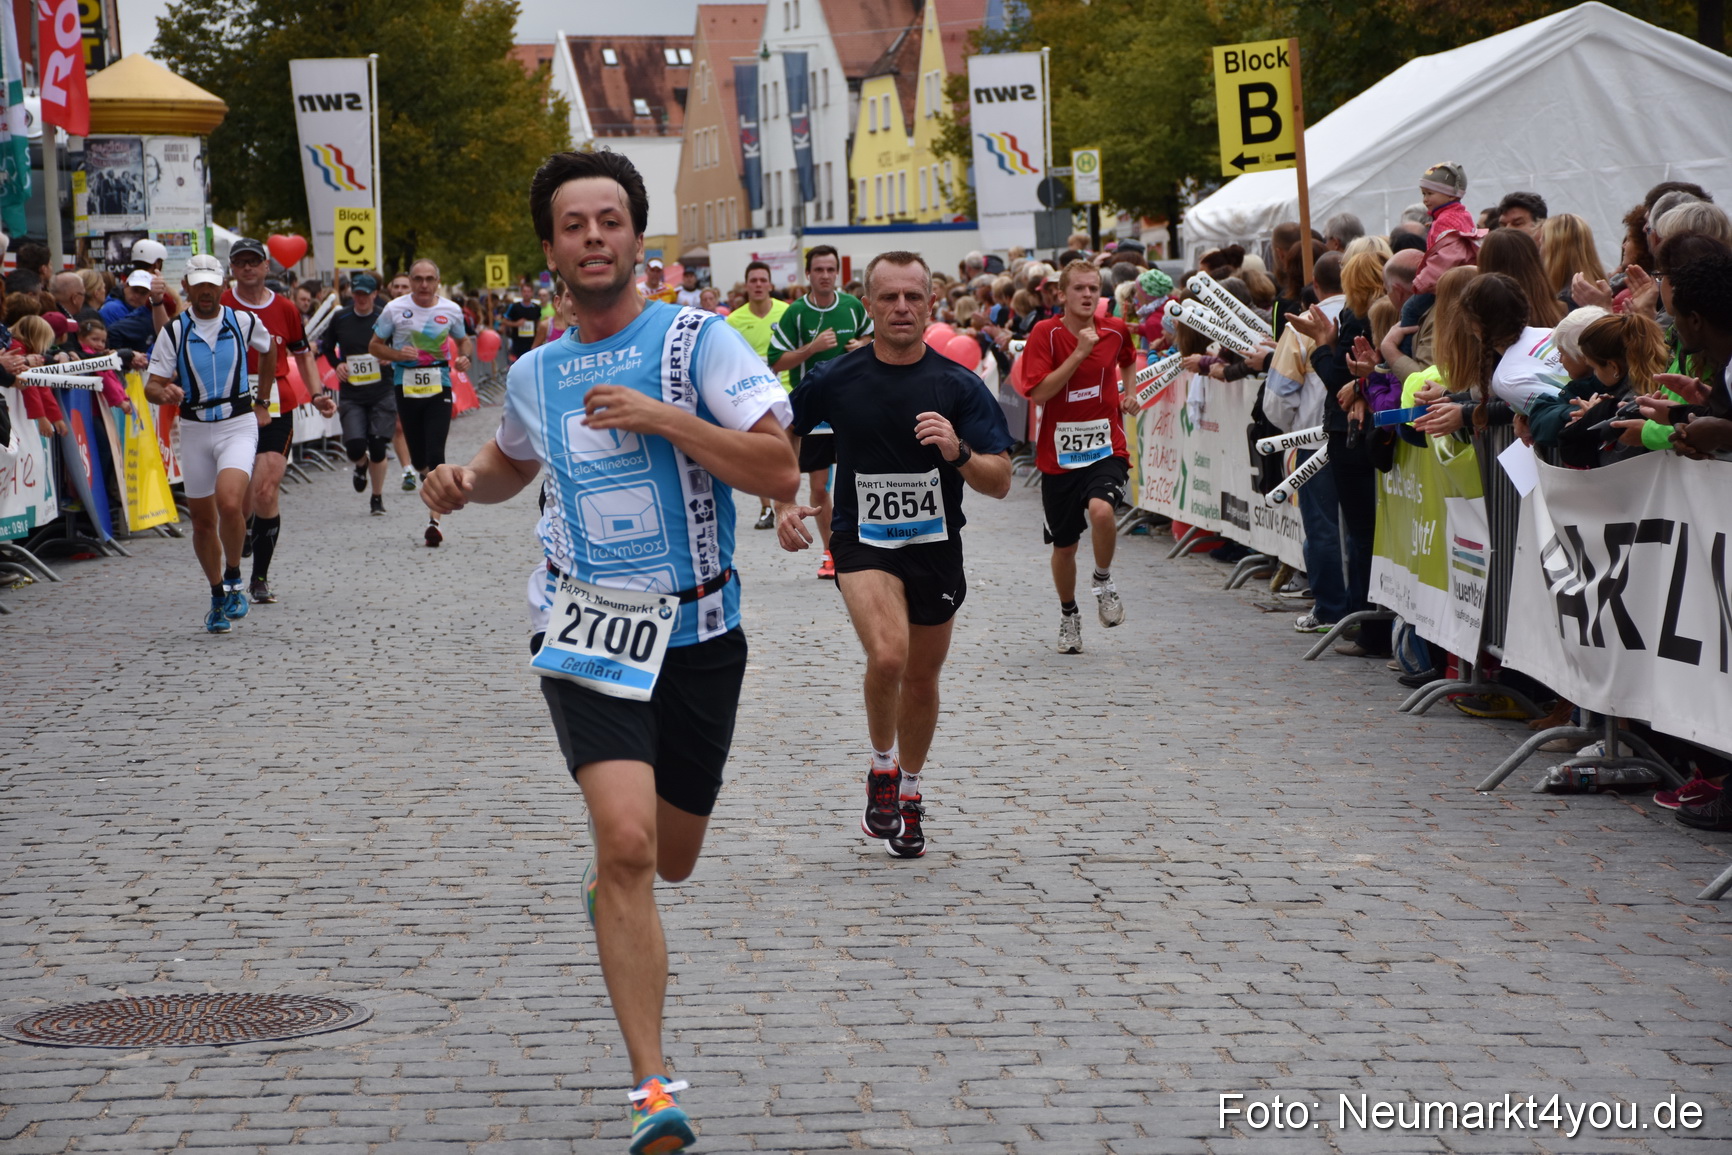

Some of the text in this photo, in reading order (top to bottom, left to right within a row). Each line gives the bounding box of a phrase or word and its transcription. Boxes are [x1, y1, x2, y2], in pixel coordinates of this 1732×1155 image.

[1224, 45, 1291, 74] Block
[1238, 81, 1284, 145] B
[338, 209, 371, 221] Block
[344, 225, 365, 255] C
[492, 265, 503, 281] D
[1203, 295, 1227, 319] BMW
[62, 357, 113, 373] Laufsport
[353, 362, 373, 374] 361
[557, 345, 643, 376] VIERTL
[670, 332, 684, 403] VIERTL
[415, 373, 430, 385] 56
[558, 369, 605, 390] DESIGN
[724, 374, 776, 397] VIERTL
[1136, 368, 1154, 384] MW
[1140, 381, 1162, 400] BMW
[1060, 432, 1106, 452] 2573
[1281, 433, 1312, 450] BMW
[573, 454, 645, 477] slacklinebox
[1070, 452, 1101, 463] Matthias
[857, 480, 927, 489] PARTL Neumarkt
[1288, 460, 1318, 490] BMW
[866, 490, 938, 521] 2654
[886, 527, 918, 538] Klaus
[592, 540, 664, 559] raumbox
[696, 527, 711, 583] IERTL
[595, 595, 654, 615] Neumarkt
[557, 602, 658, 663] 2700
[561, 657, 624, 681] Gerhard
